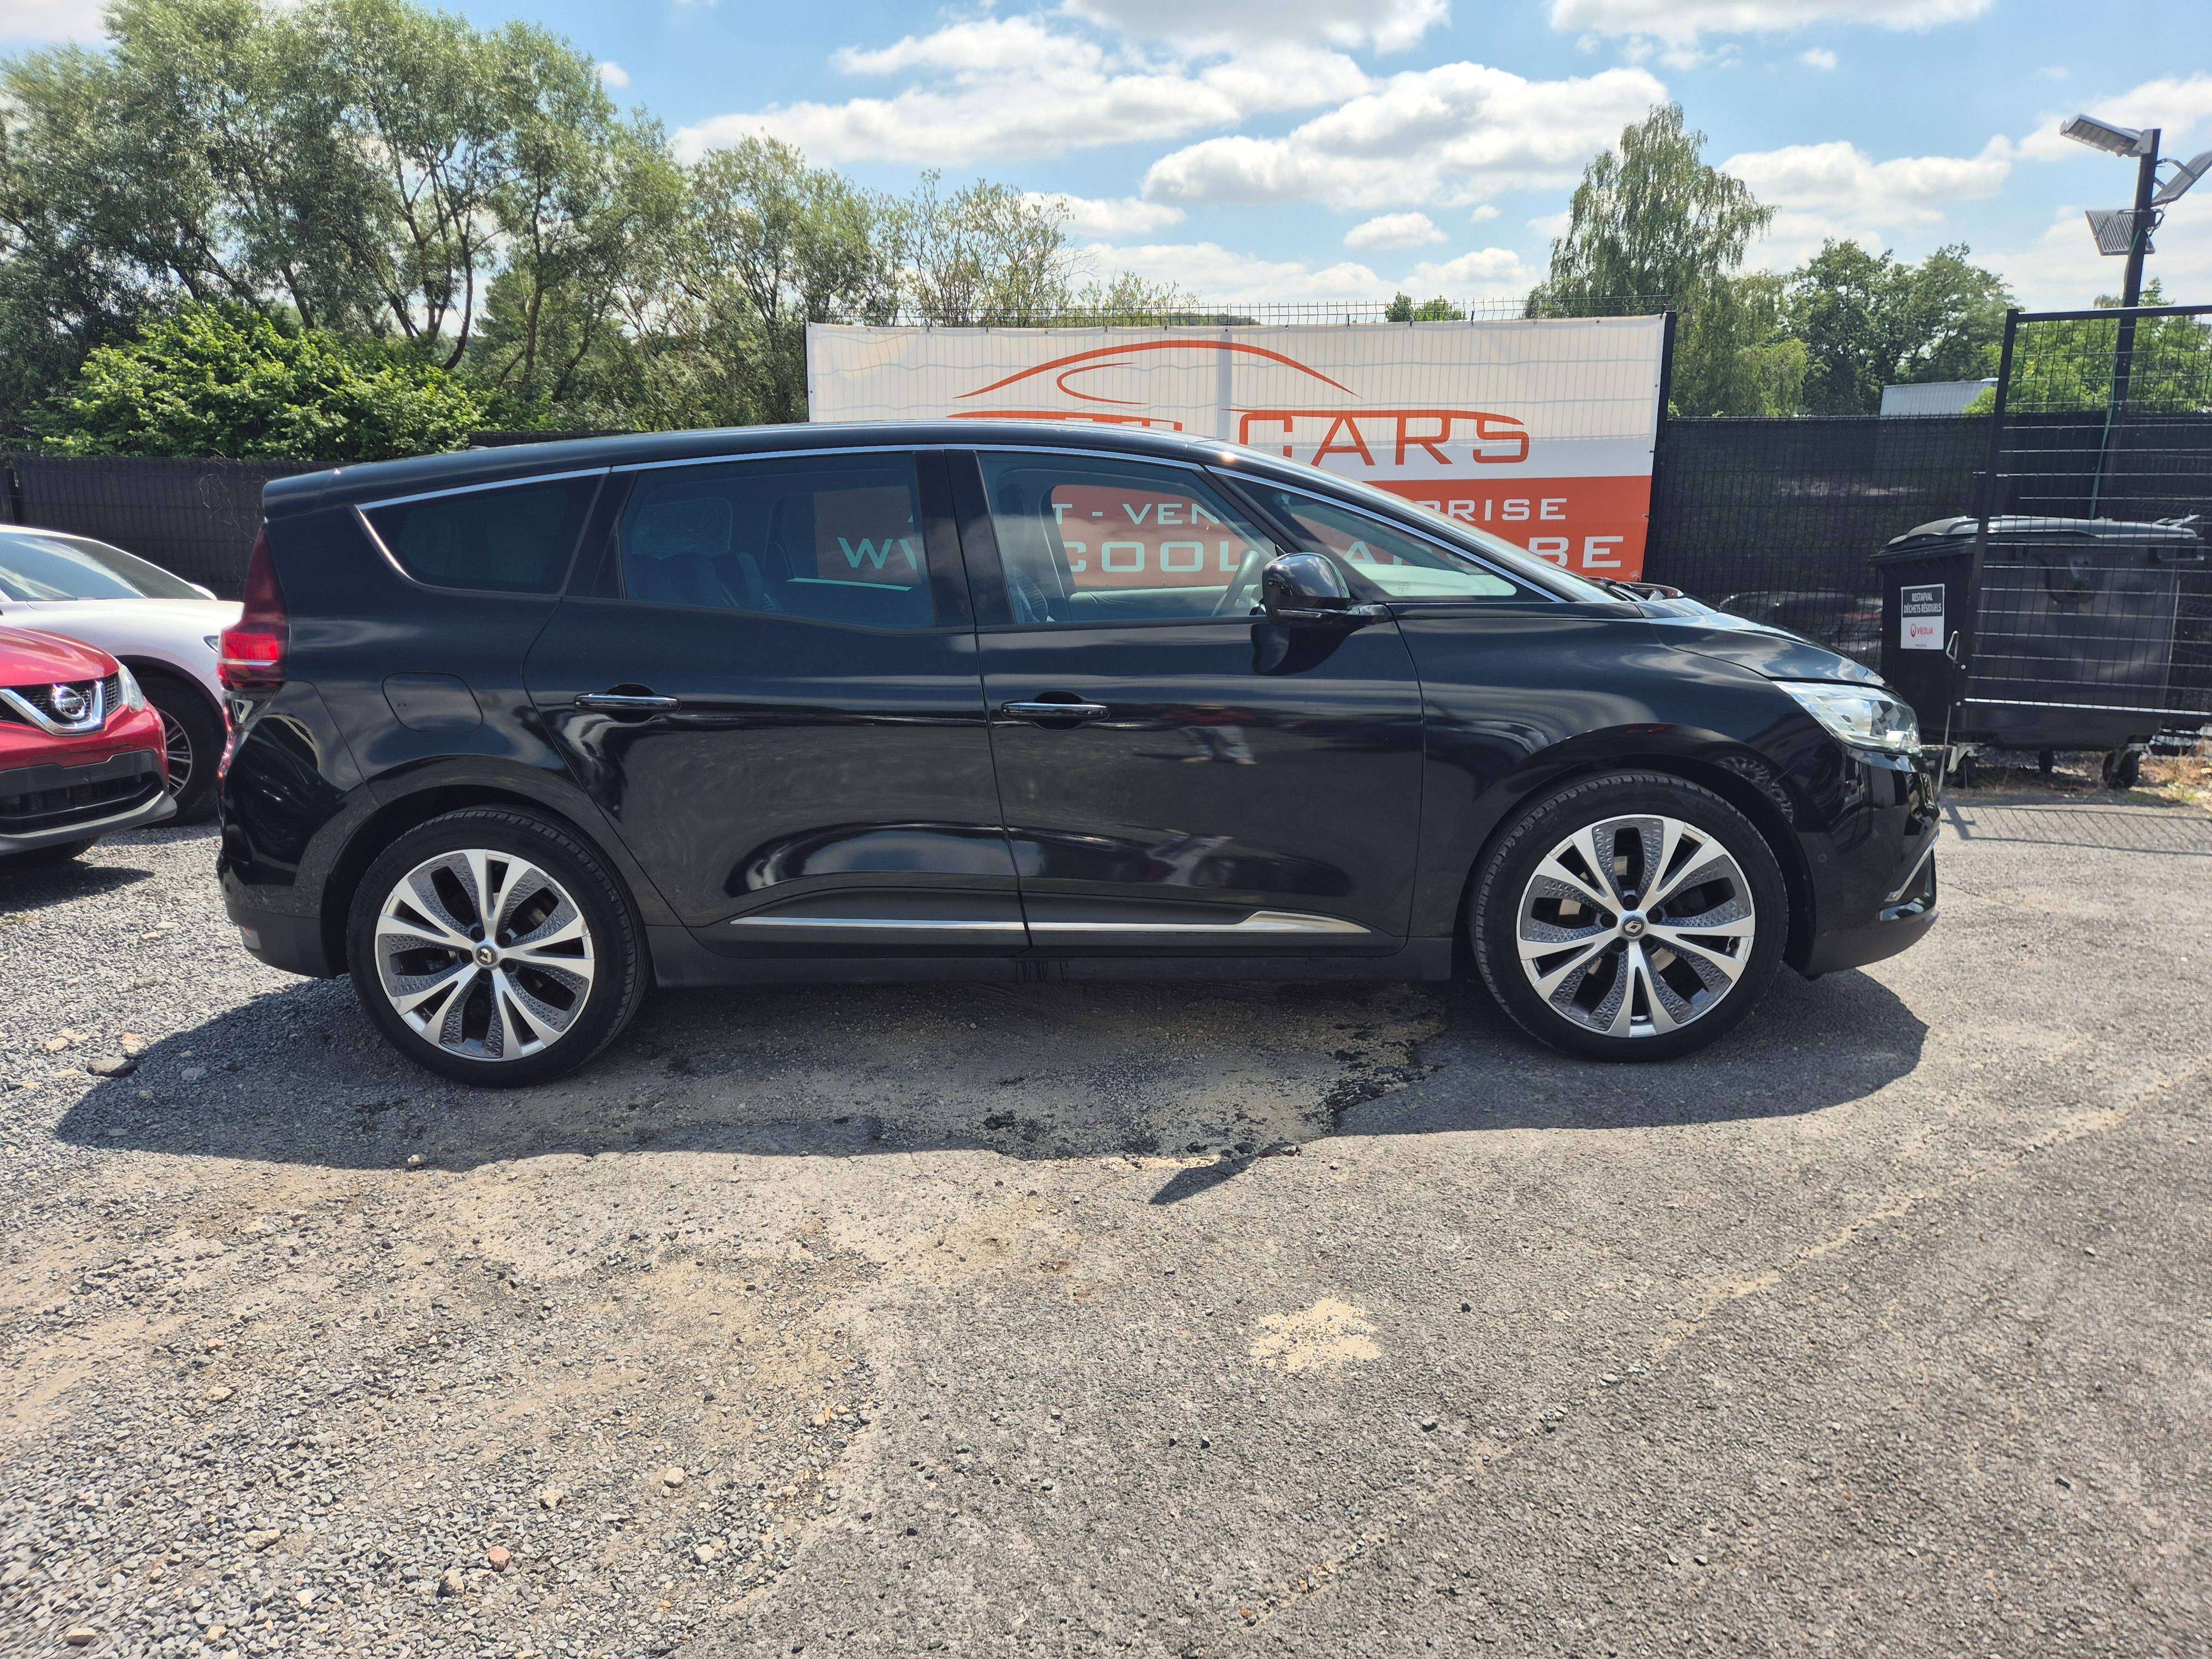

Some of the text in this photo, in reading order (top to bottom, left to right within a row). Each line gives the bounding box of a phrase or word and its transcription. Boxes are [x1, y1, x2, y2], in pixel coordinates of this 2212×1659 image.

[1222, 409, 1530, 466] CARS
[1903, 602, 1921, 613] DÉCHETS
[1917, 627, 1933, 635] VEOLIA
